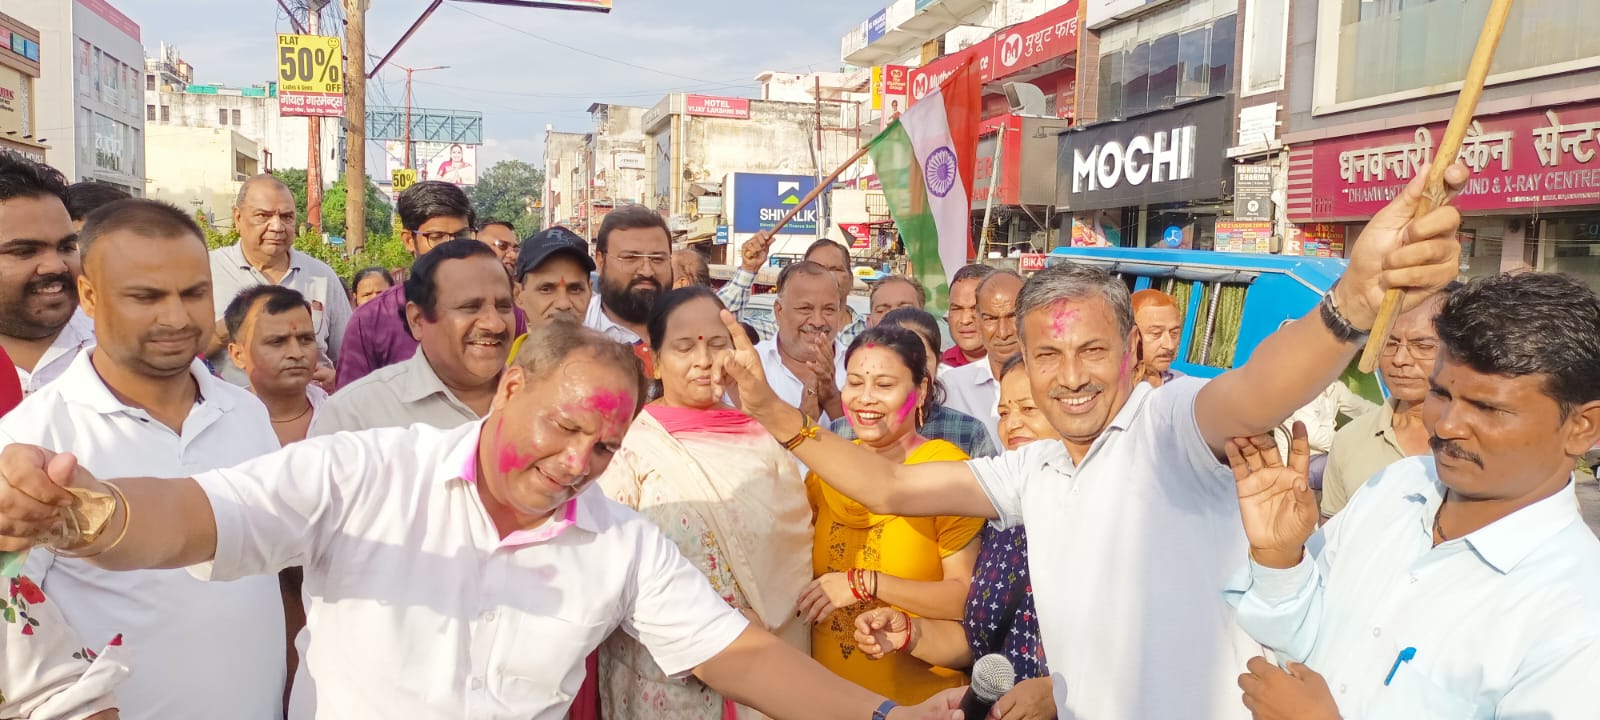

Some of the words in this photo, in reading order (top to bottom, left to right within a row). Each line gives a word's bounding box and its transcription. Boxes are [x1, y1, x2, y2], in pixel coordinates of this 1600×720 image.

[279, 35, 299, 45] FLAT
[280, 46, 339, 83] 50%
[325, 83, 342, 92] OFF
[703, 99, 730, 108] HOTEL
[1339, 126, 1433, 184] धनवन्तरी
[1532, 108, 1600, 168] सेन्ट
[1072, 125, 1197, 193] MOCHI
[393, 173, 416, 188] 50%
[1491, 176, 1501, 194] &
[1504, 174, 1542, 193] X-RAY
[1544, 168, 1600, 190] CENTRE
